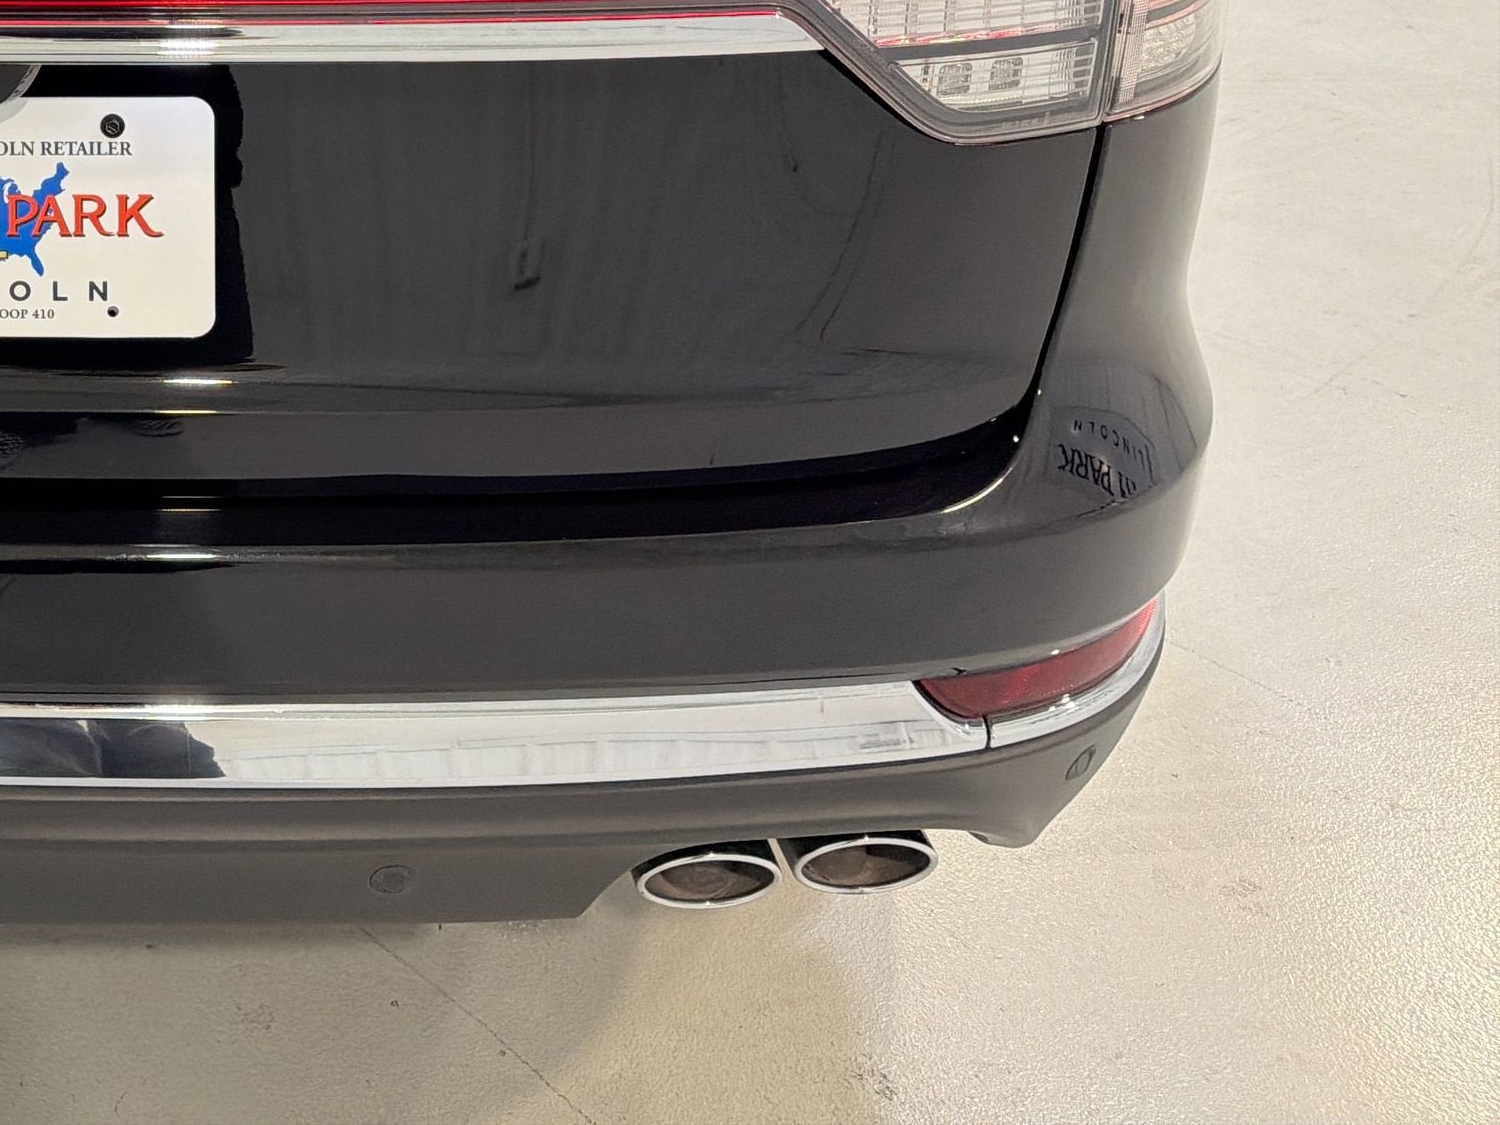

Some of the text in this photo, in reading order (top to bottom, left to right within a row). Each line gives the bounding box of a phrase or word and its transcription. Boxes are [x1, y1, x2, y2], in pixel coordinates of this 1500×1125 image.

[40, 141, 132, 156] RETAILER
[6, 194, 165, 238] PARK
[31, 308, 55, 319] 410
